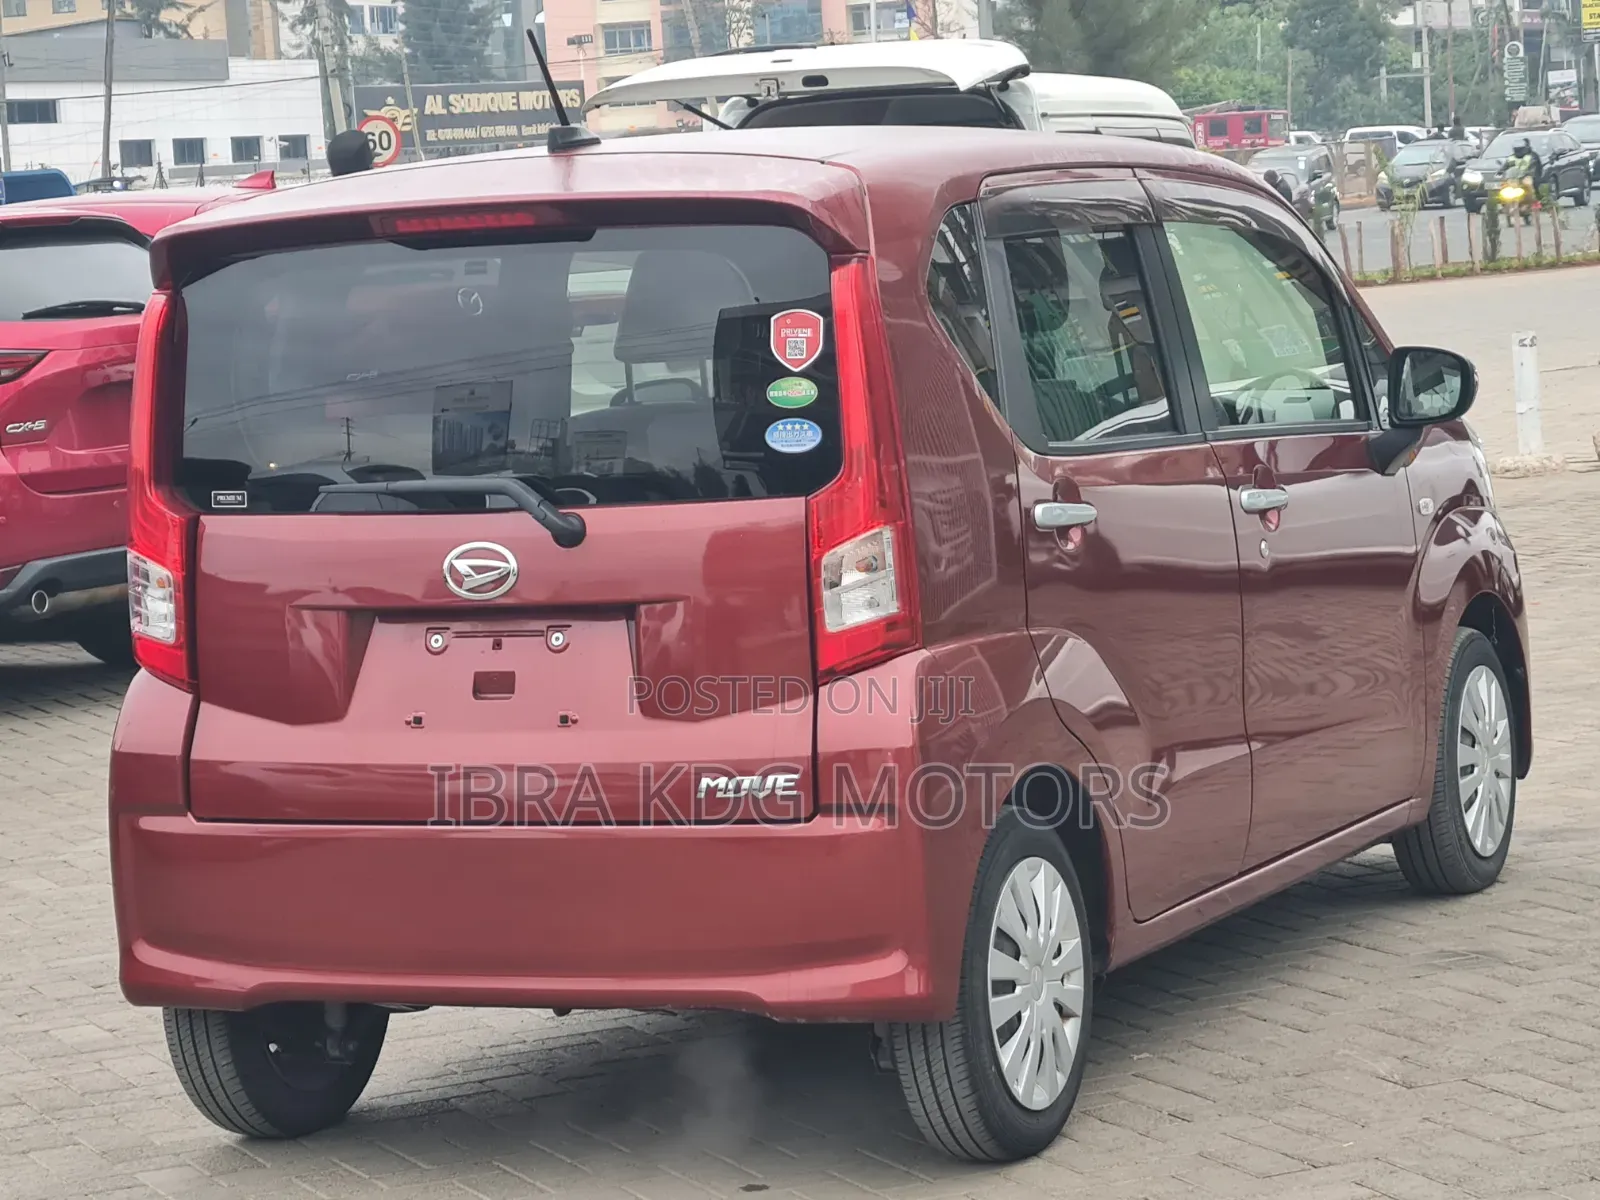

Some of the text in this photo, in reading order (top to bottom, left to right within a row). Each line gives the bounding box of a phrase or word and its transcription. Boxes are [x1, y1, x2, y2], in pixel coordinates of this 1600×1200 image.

[424, 94, 448, 115] AL
[366, 130, 392, 152] 60
[6, 420, 47, 433] CX-5
[696, 773, 801, 799] MOVE
